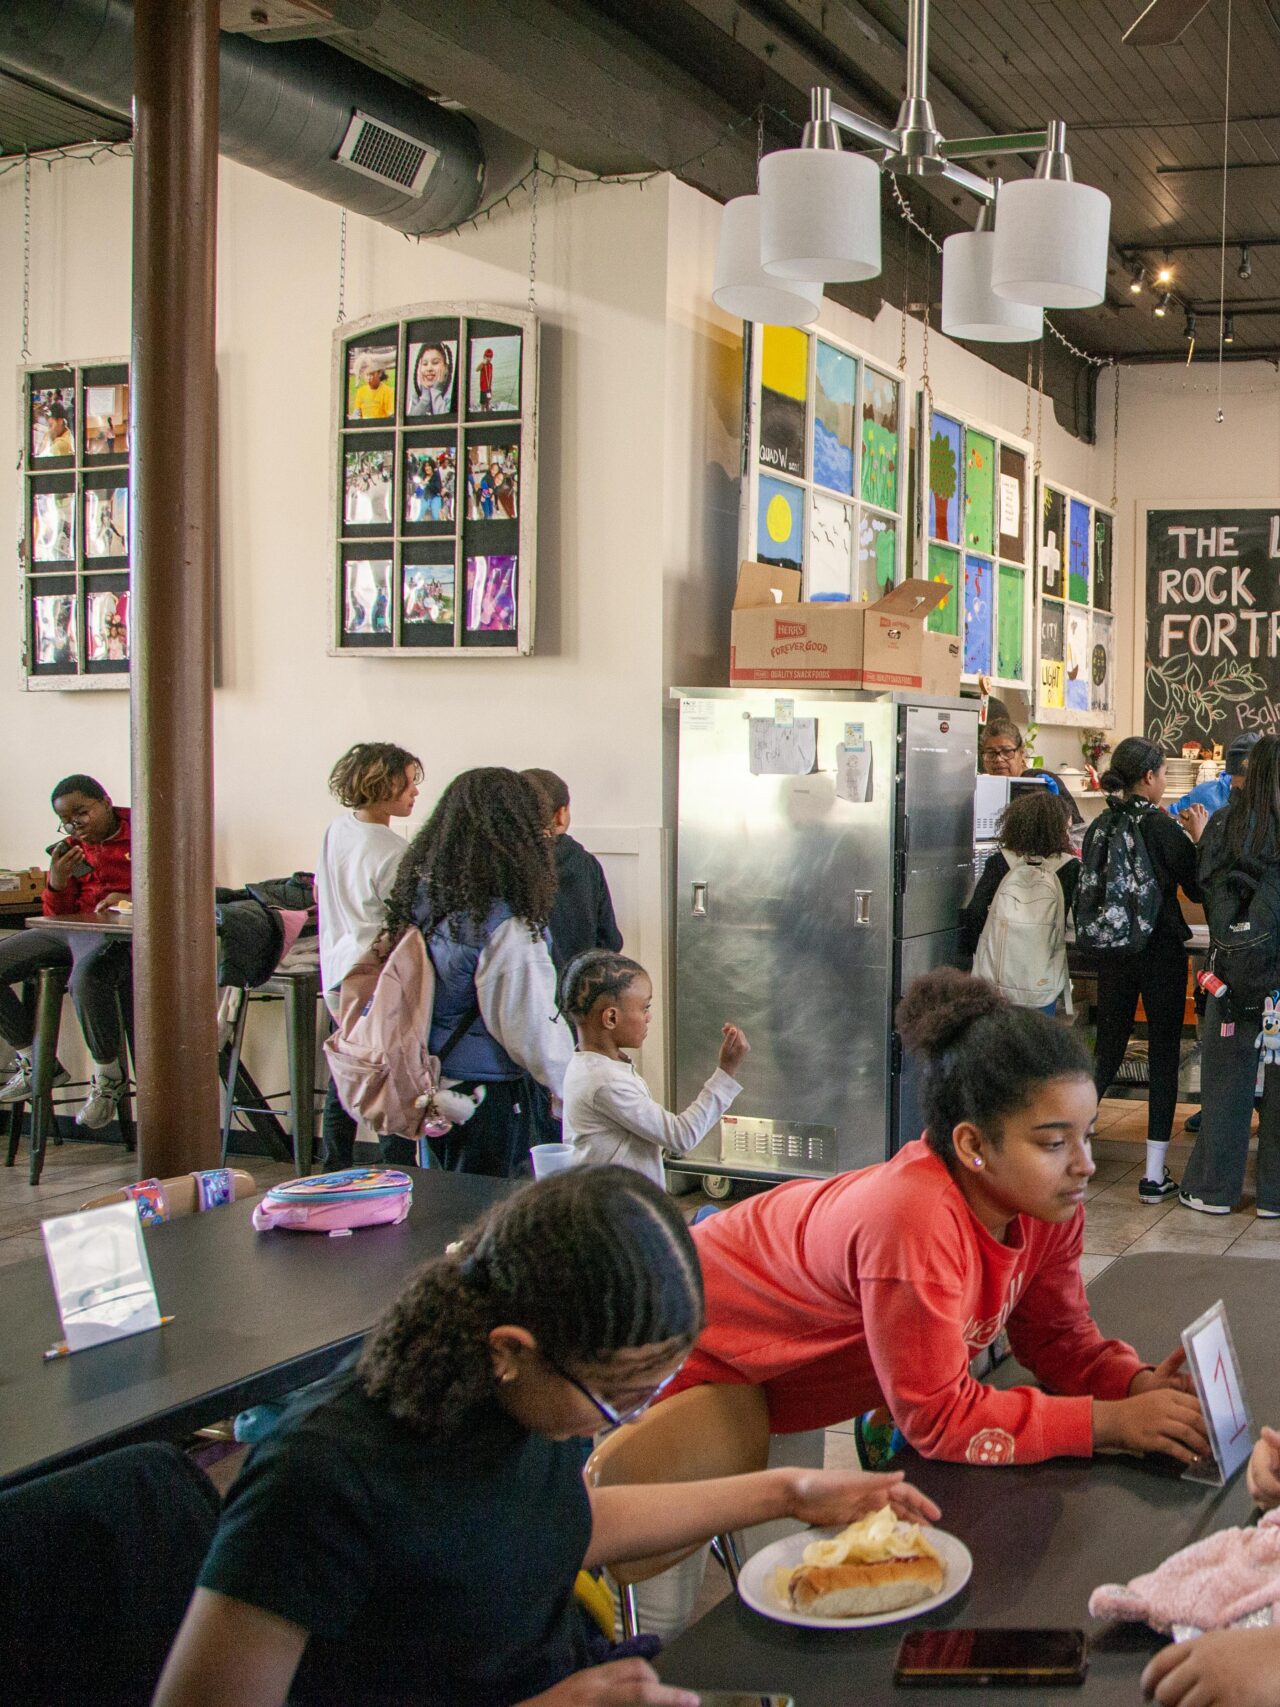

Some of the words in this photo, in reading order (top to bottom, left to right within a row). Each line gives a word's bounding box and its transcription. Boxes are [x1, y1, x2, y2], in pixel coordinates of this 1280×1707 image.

[1168, 526, 1239, 559] THE
[1158, 566, 1256, 605] ROCK
[805, 640, 828, 653] GOOD
[1041, 622, 1057, 642] CITY
[1213, 1351, 1248, 1445] 1
